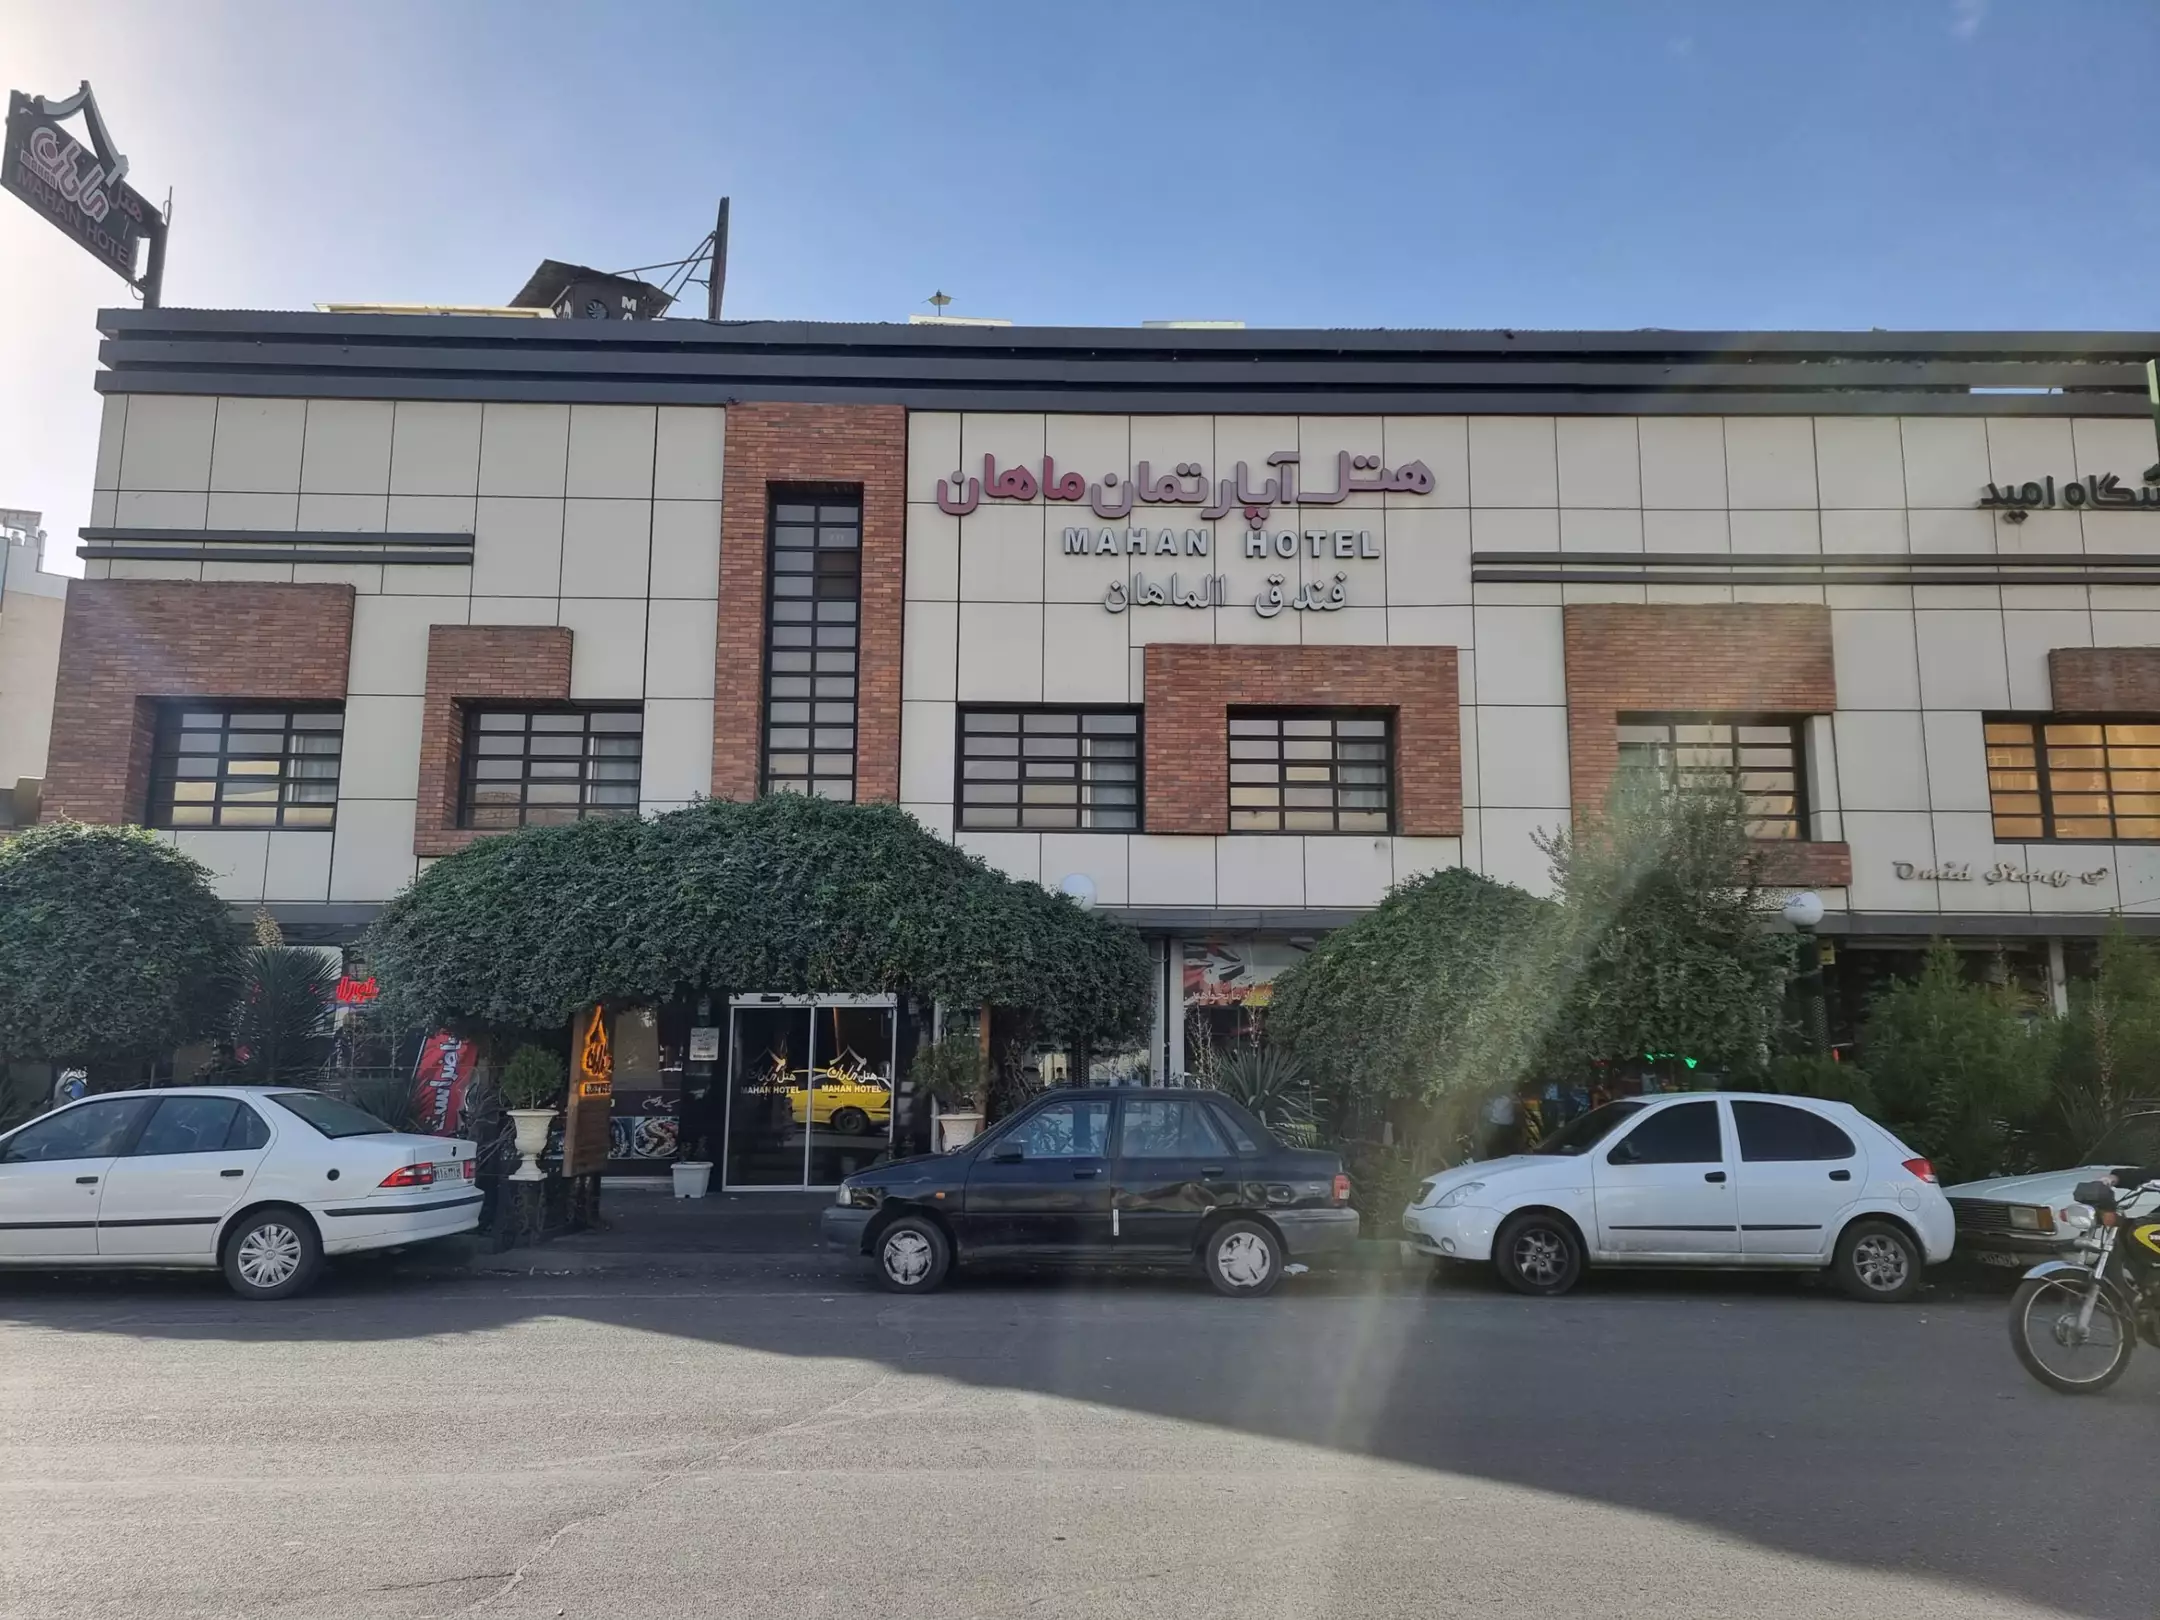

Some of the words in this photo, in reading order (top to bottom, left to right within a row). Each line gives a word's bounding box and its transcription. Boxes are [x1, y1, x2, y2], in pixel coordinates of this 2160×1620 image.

[17, 170, 82, 229] MAHAN
[936, 453, 1086, 516] ماهان
[1091, 451, 1300, 529] آپارتمان
[1297, 450, 1436, 504] هتل
[1978, 475, 2056, 525] امید
[1064, 527, 1208, 557] MAHAN
[1245, 529, 1381, 559] HOTEL
[1104, 572, 1226, 614] الماهان
[1254, 571, 1348, 618] فندق
[741, 1085, 771, 1094] MAHAN
[773, 1085, 800, 1094] HOTEL
[821, 1085, 852, 1093] MAHAN
[854, 1085, 881, 1093] HOTEL
[826, 1063, 858, 1081] ماهان
[857, 1069, 878, 1083] هتل
